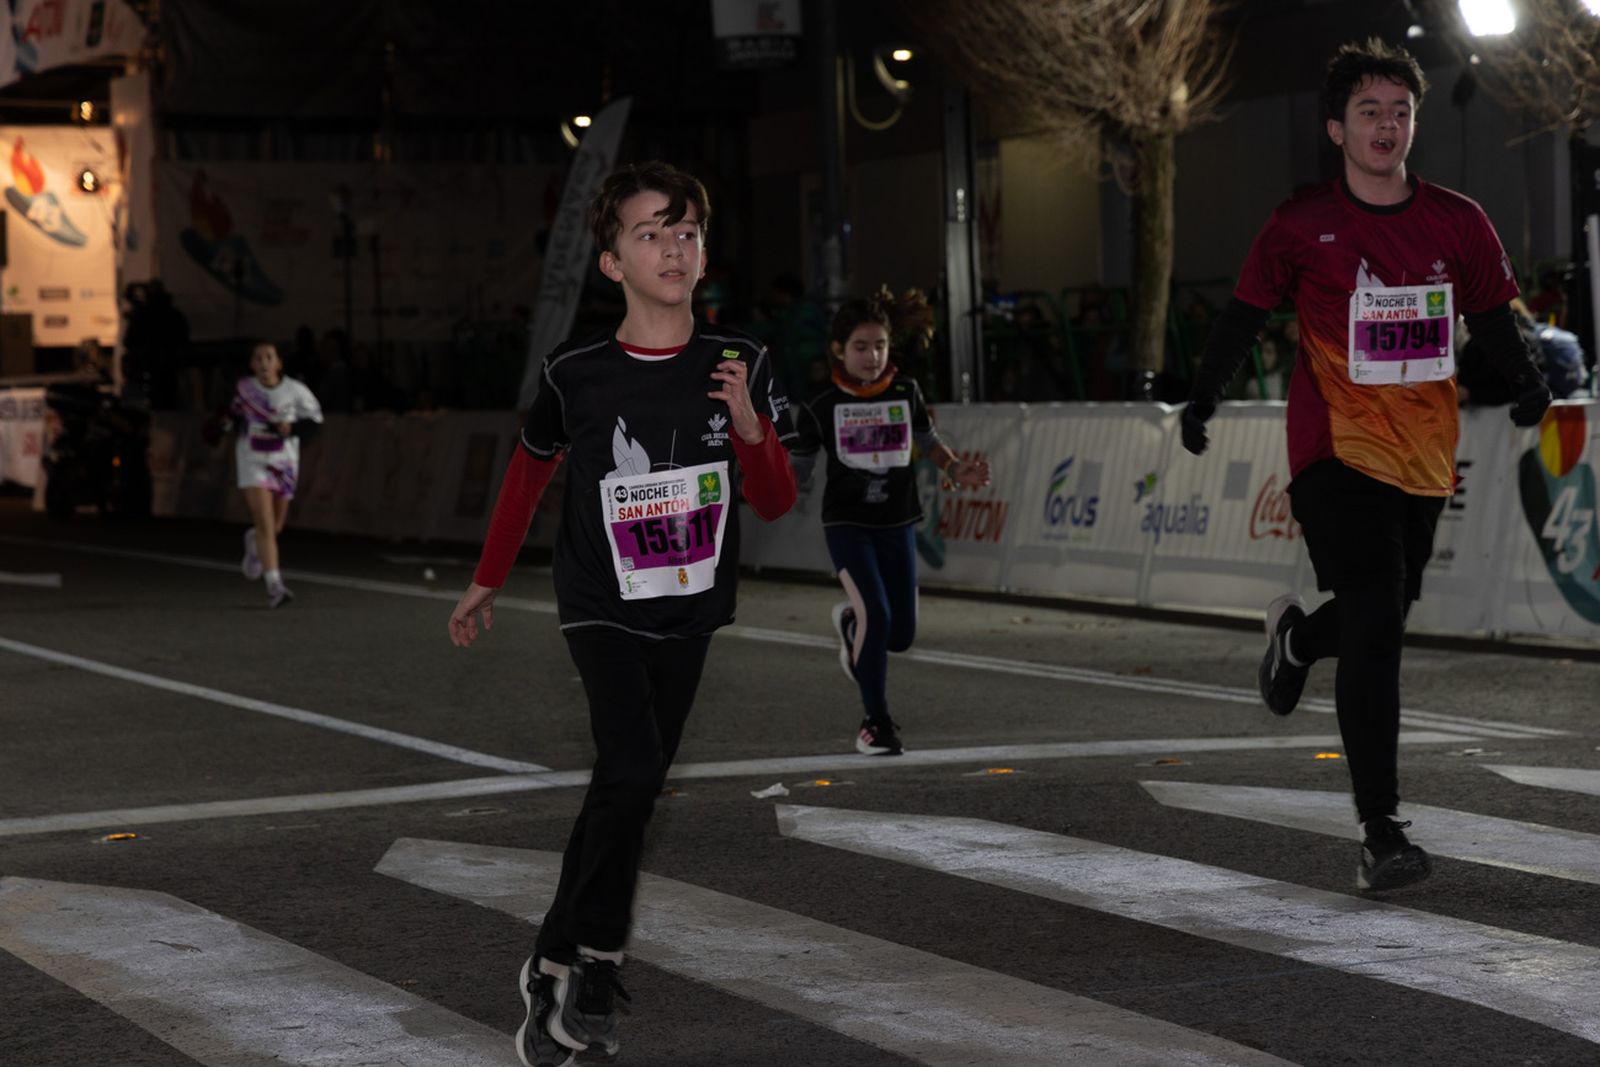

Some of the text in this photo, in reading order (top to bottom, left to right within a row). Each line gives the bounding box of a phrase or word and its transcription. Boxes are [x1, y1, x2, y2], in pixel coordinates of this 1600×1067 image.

[1375, 297, 1405, 308] NOCHE
[1406, 296, 1417, 306] DE
[1386, 306, 1418, 319] ANTÓN
[1366, 320, 1441, 351] 15794
[630, 485, 669, 502] NOCHE
[672, 483, 688, 497] DE
[618, 496, 690, 520] SAN ANTÓN
[1141, 493, 1209, 545] aqualia
[628, 508, 715, 556] 15511
[1541, 486, 1593, 574] 43
